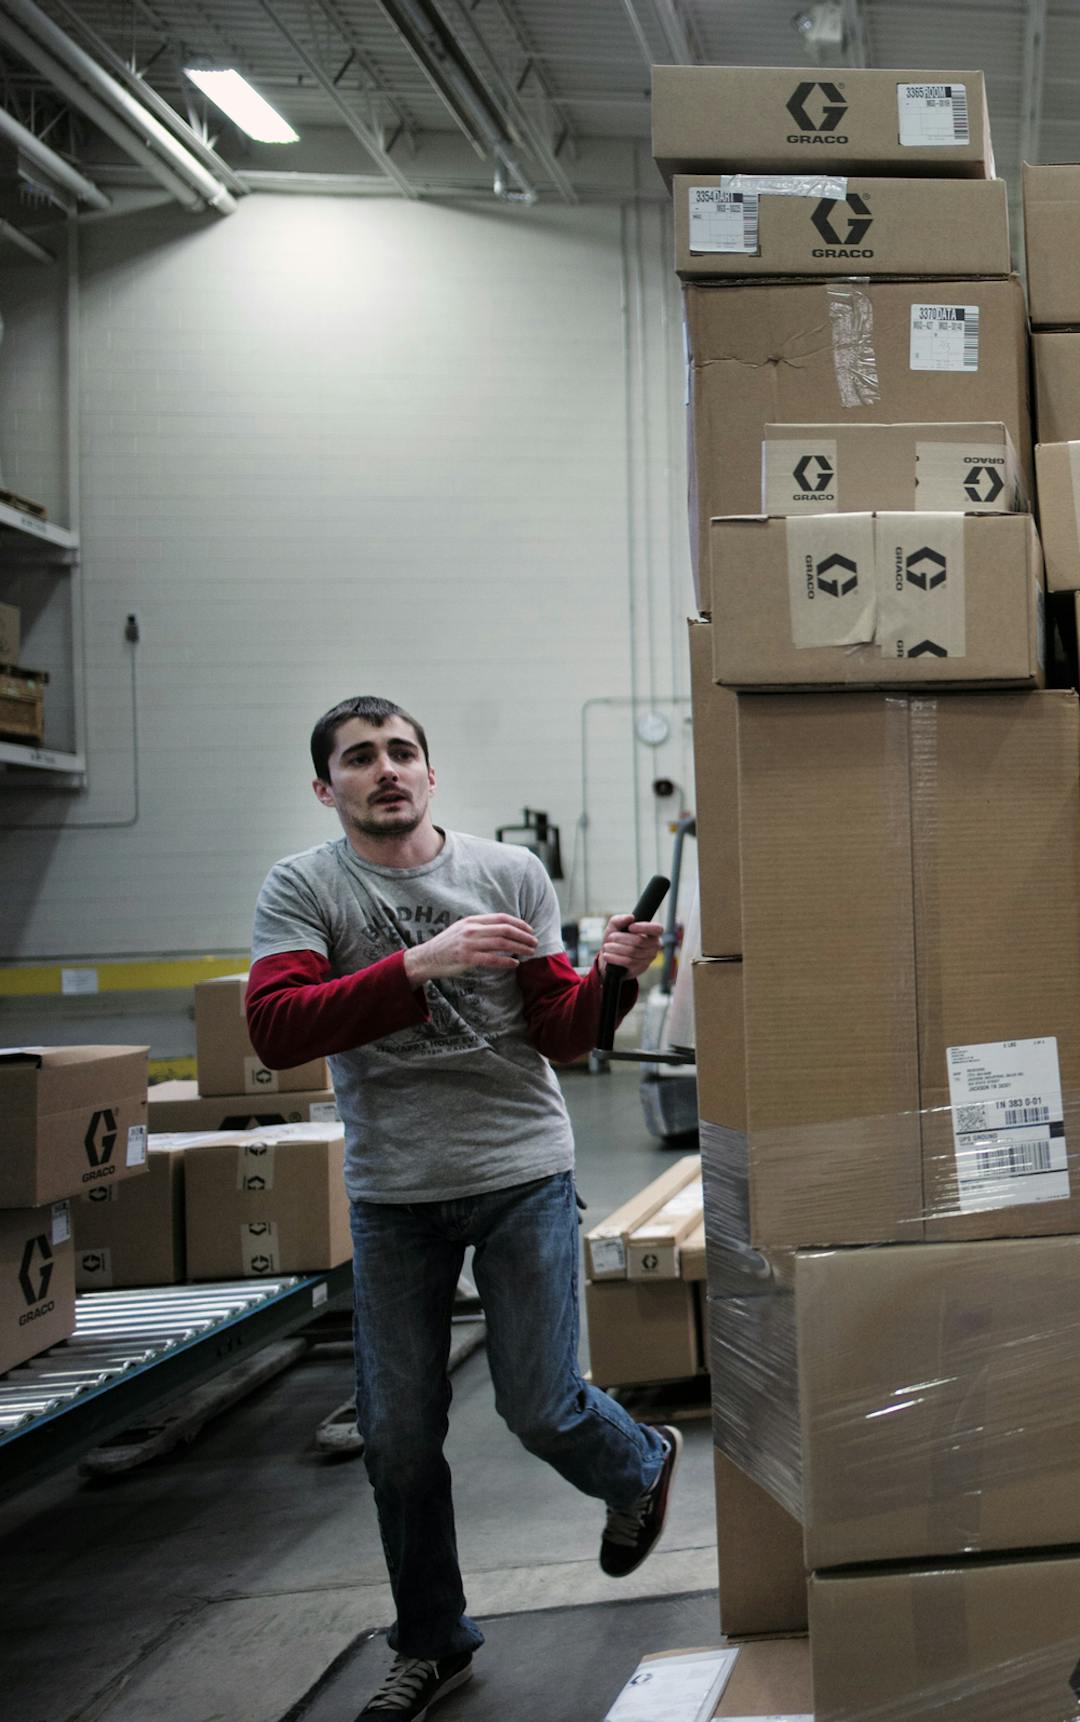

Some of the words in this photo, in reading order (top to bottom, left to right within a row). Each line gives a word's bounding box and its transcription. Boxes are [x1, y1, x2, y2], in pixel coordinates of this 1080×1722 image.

[786, 135, 849, 144] GRACO
[811, 249, 874, 259] GRACO
[805, 554, 815, 600] GRACO
[895, 546, 903, 592] GRACO
[1008, 1098, 1023, 1108] 383
[82, 1165, 116, 1183] GRACO
[18, 1300, 55, 1327] GRACO
